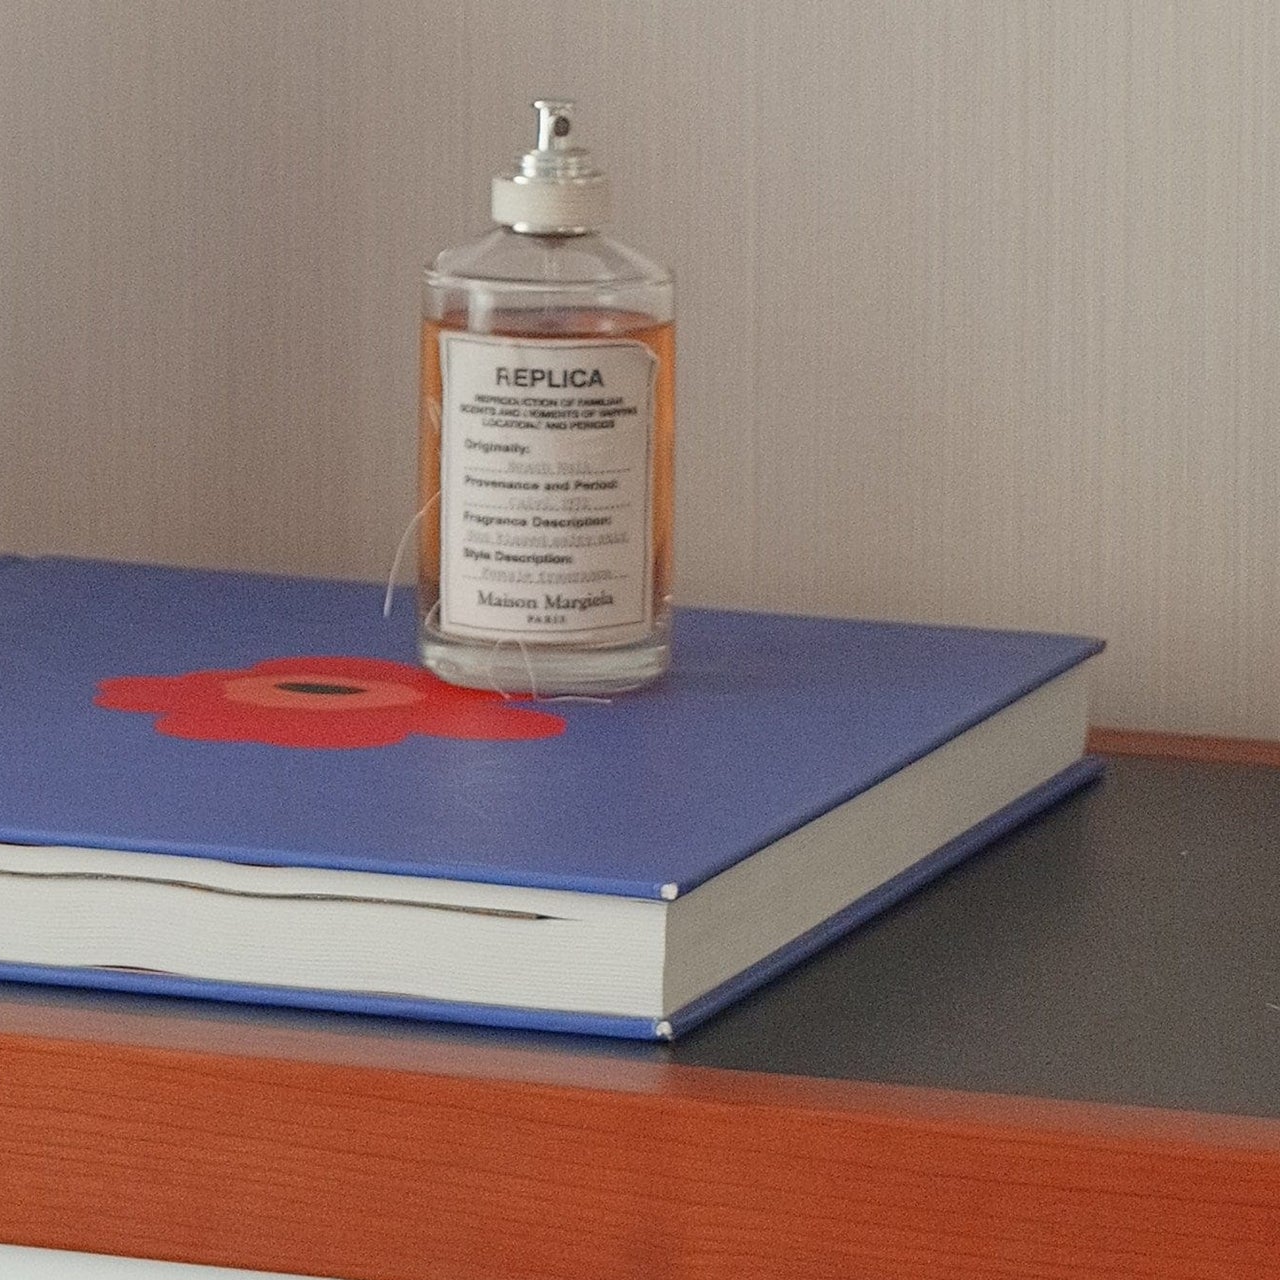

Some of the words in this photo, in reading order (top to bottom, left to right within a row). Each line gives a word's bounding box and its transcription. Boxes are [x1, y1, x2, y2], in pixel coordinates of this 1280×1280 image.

[495, 366, 604, 388] REPLICA
[463, 438, 530, 455] Originally:
[463, 475, 539, 490] Provenance
[542, 481, 569, 490] and
[573, 479, 618, 490] Period:
[463, 510, 527, 526] Fragrance
[531, 516, 612, 528] Description:
[462, 547, 491, 561] Style
[494, 551, 573, 564] Description:
[477, 589, 537, 608] Maison
[543, 589, 614, 612] Margiela
